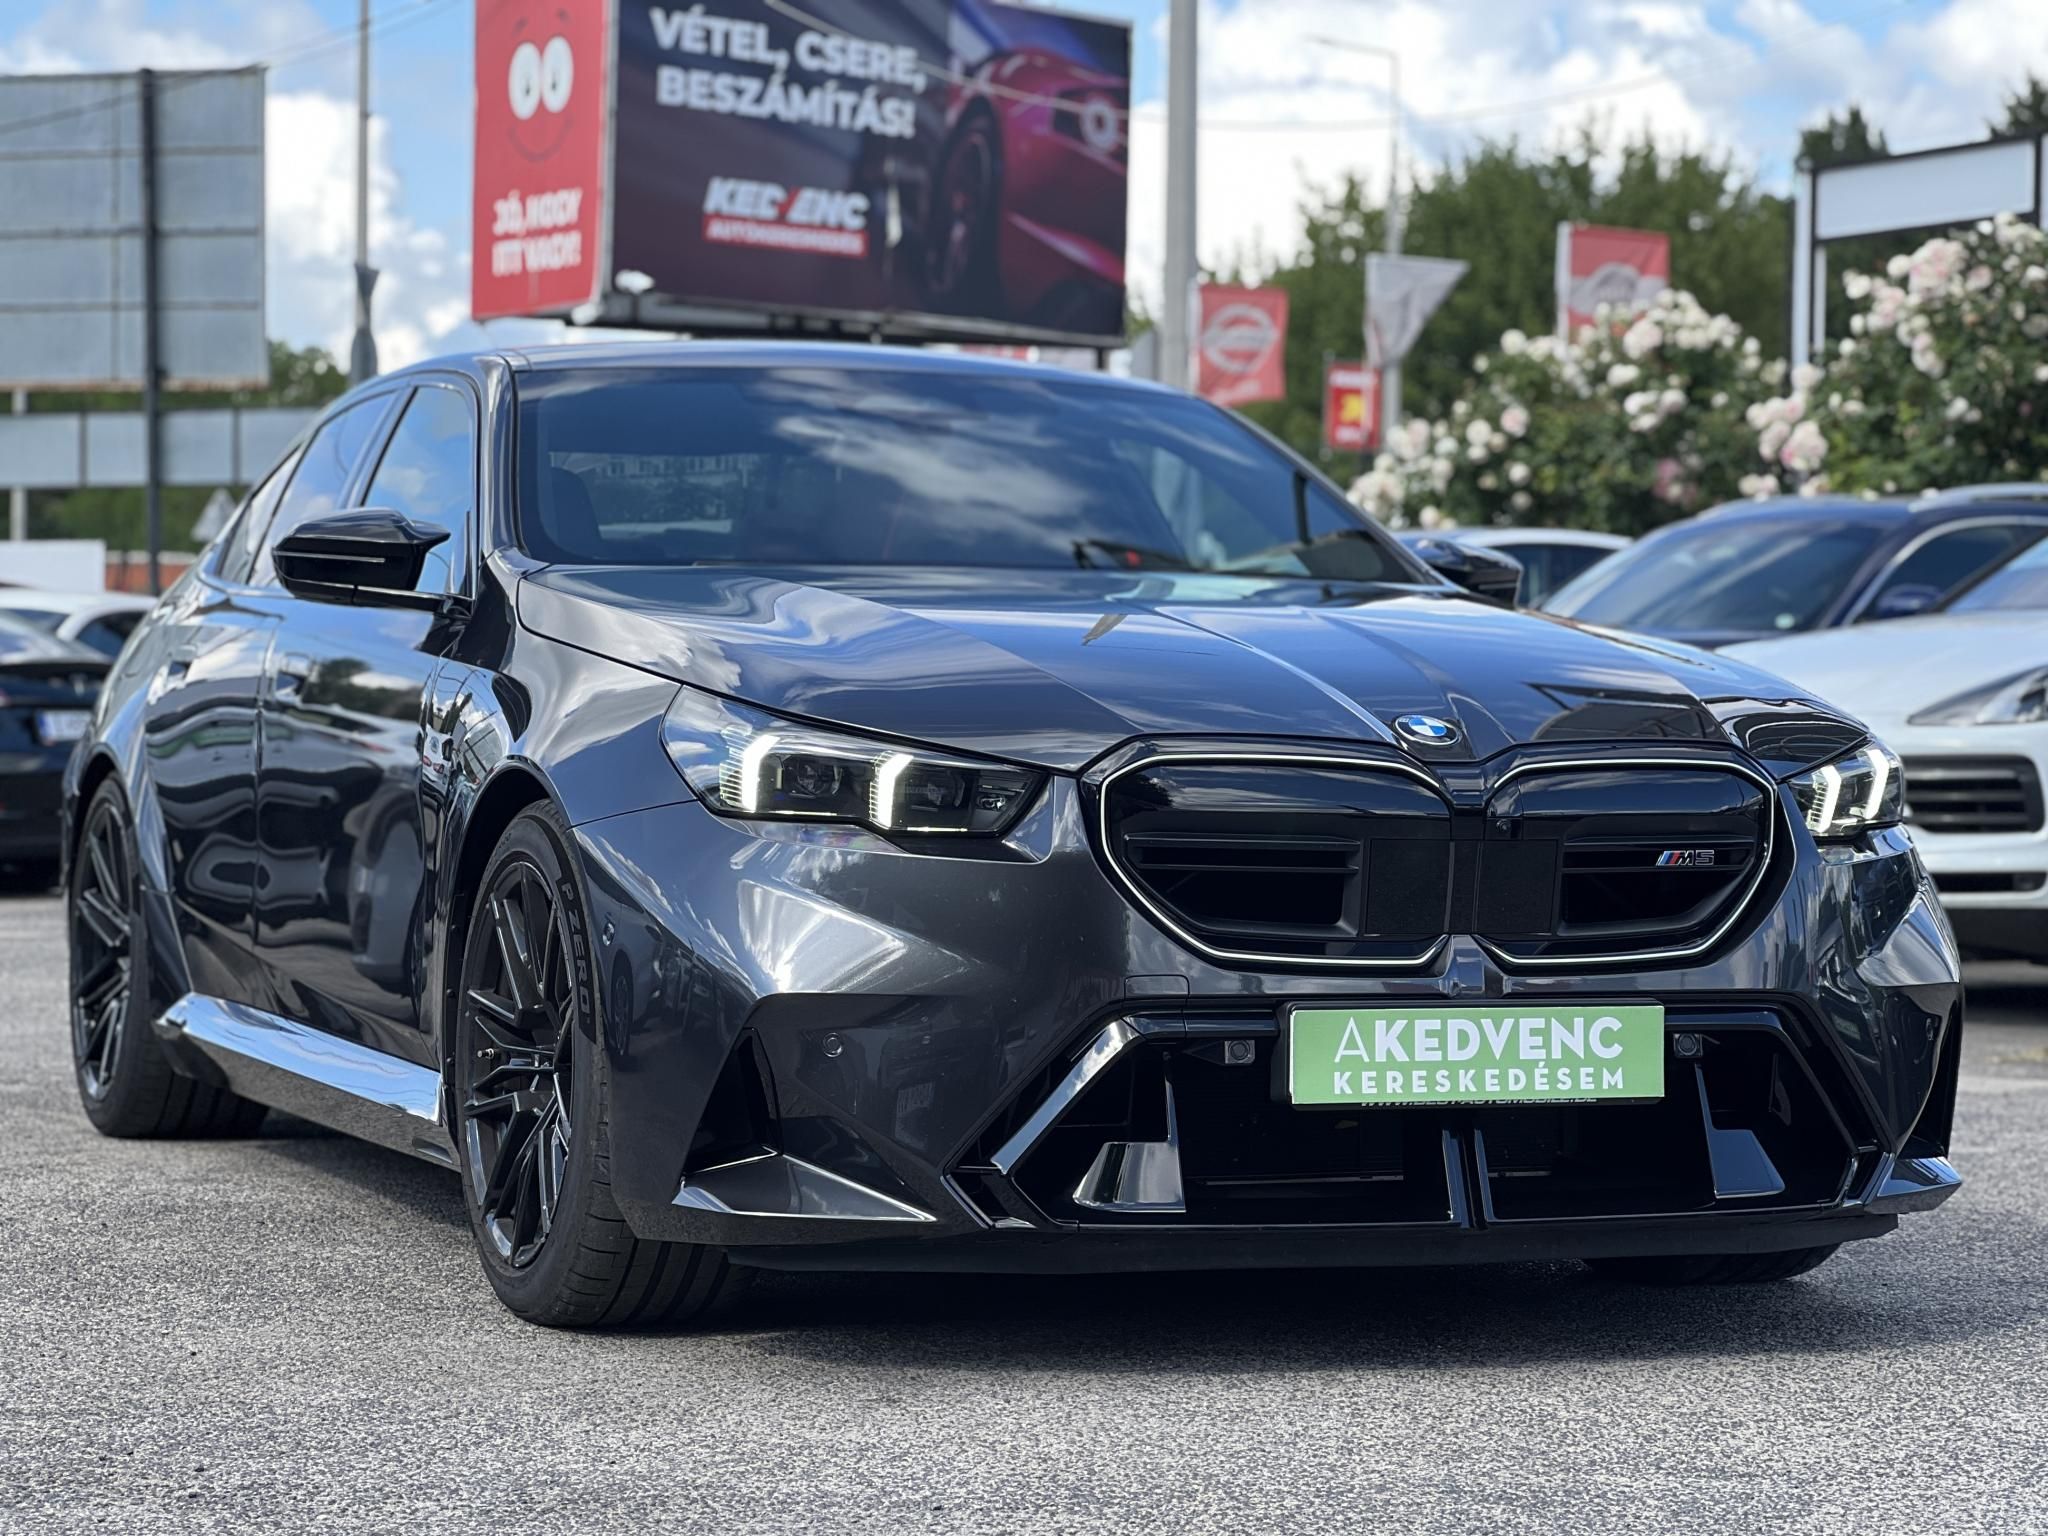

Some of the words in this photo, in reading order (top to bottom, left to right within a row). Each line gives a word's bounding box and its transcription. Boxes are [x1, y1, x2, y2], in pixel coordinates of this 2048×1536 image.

[649, 4, 790, 71] VÉTEL,
[795, 31, 928, 94] CSERE,
[656, 65, 917, 139] BESZÁMÍTÁS!
[1676, 849, 1715, 866] M5
[568, 909, 591, 1014] ZERO
[1333, 1061, 1624, 1095] KERESKEDÉSEM
